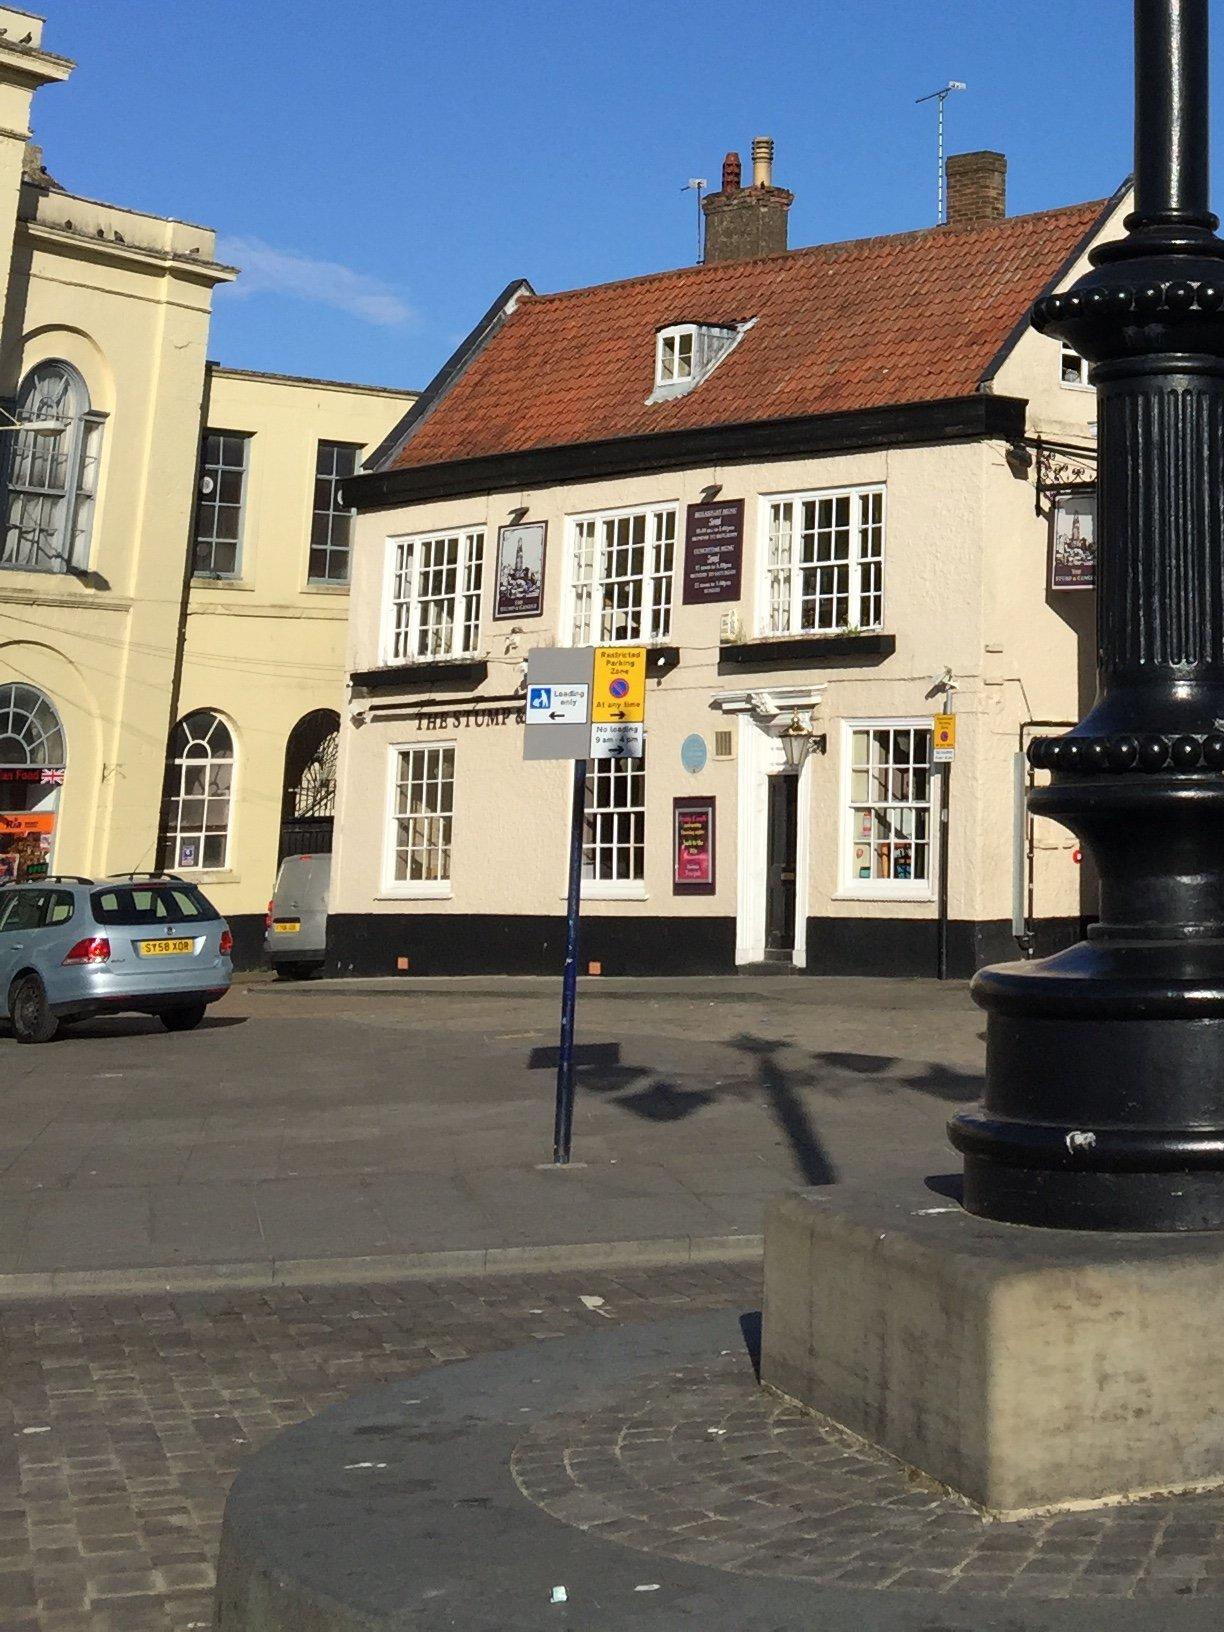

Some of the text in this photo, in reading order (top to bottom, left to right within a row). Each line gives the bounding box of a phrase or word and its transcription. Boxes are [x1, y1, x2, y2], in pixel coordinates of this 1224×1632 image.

[600, 651, 641, 659] Restricted
[606, 660, 635, 668] Parking
[554, 690, 585, 698] Loading
[560, 699, 577, 707] only
[607, 702, 622, 710] any
[416, 711, 448, 731] THE
[452, 707, 510, 729] STUMP
[610, 725, 639, 734] loading
[145, 941, 189, 952] SY58 XOR
